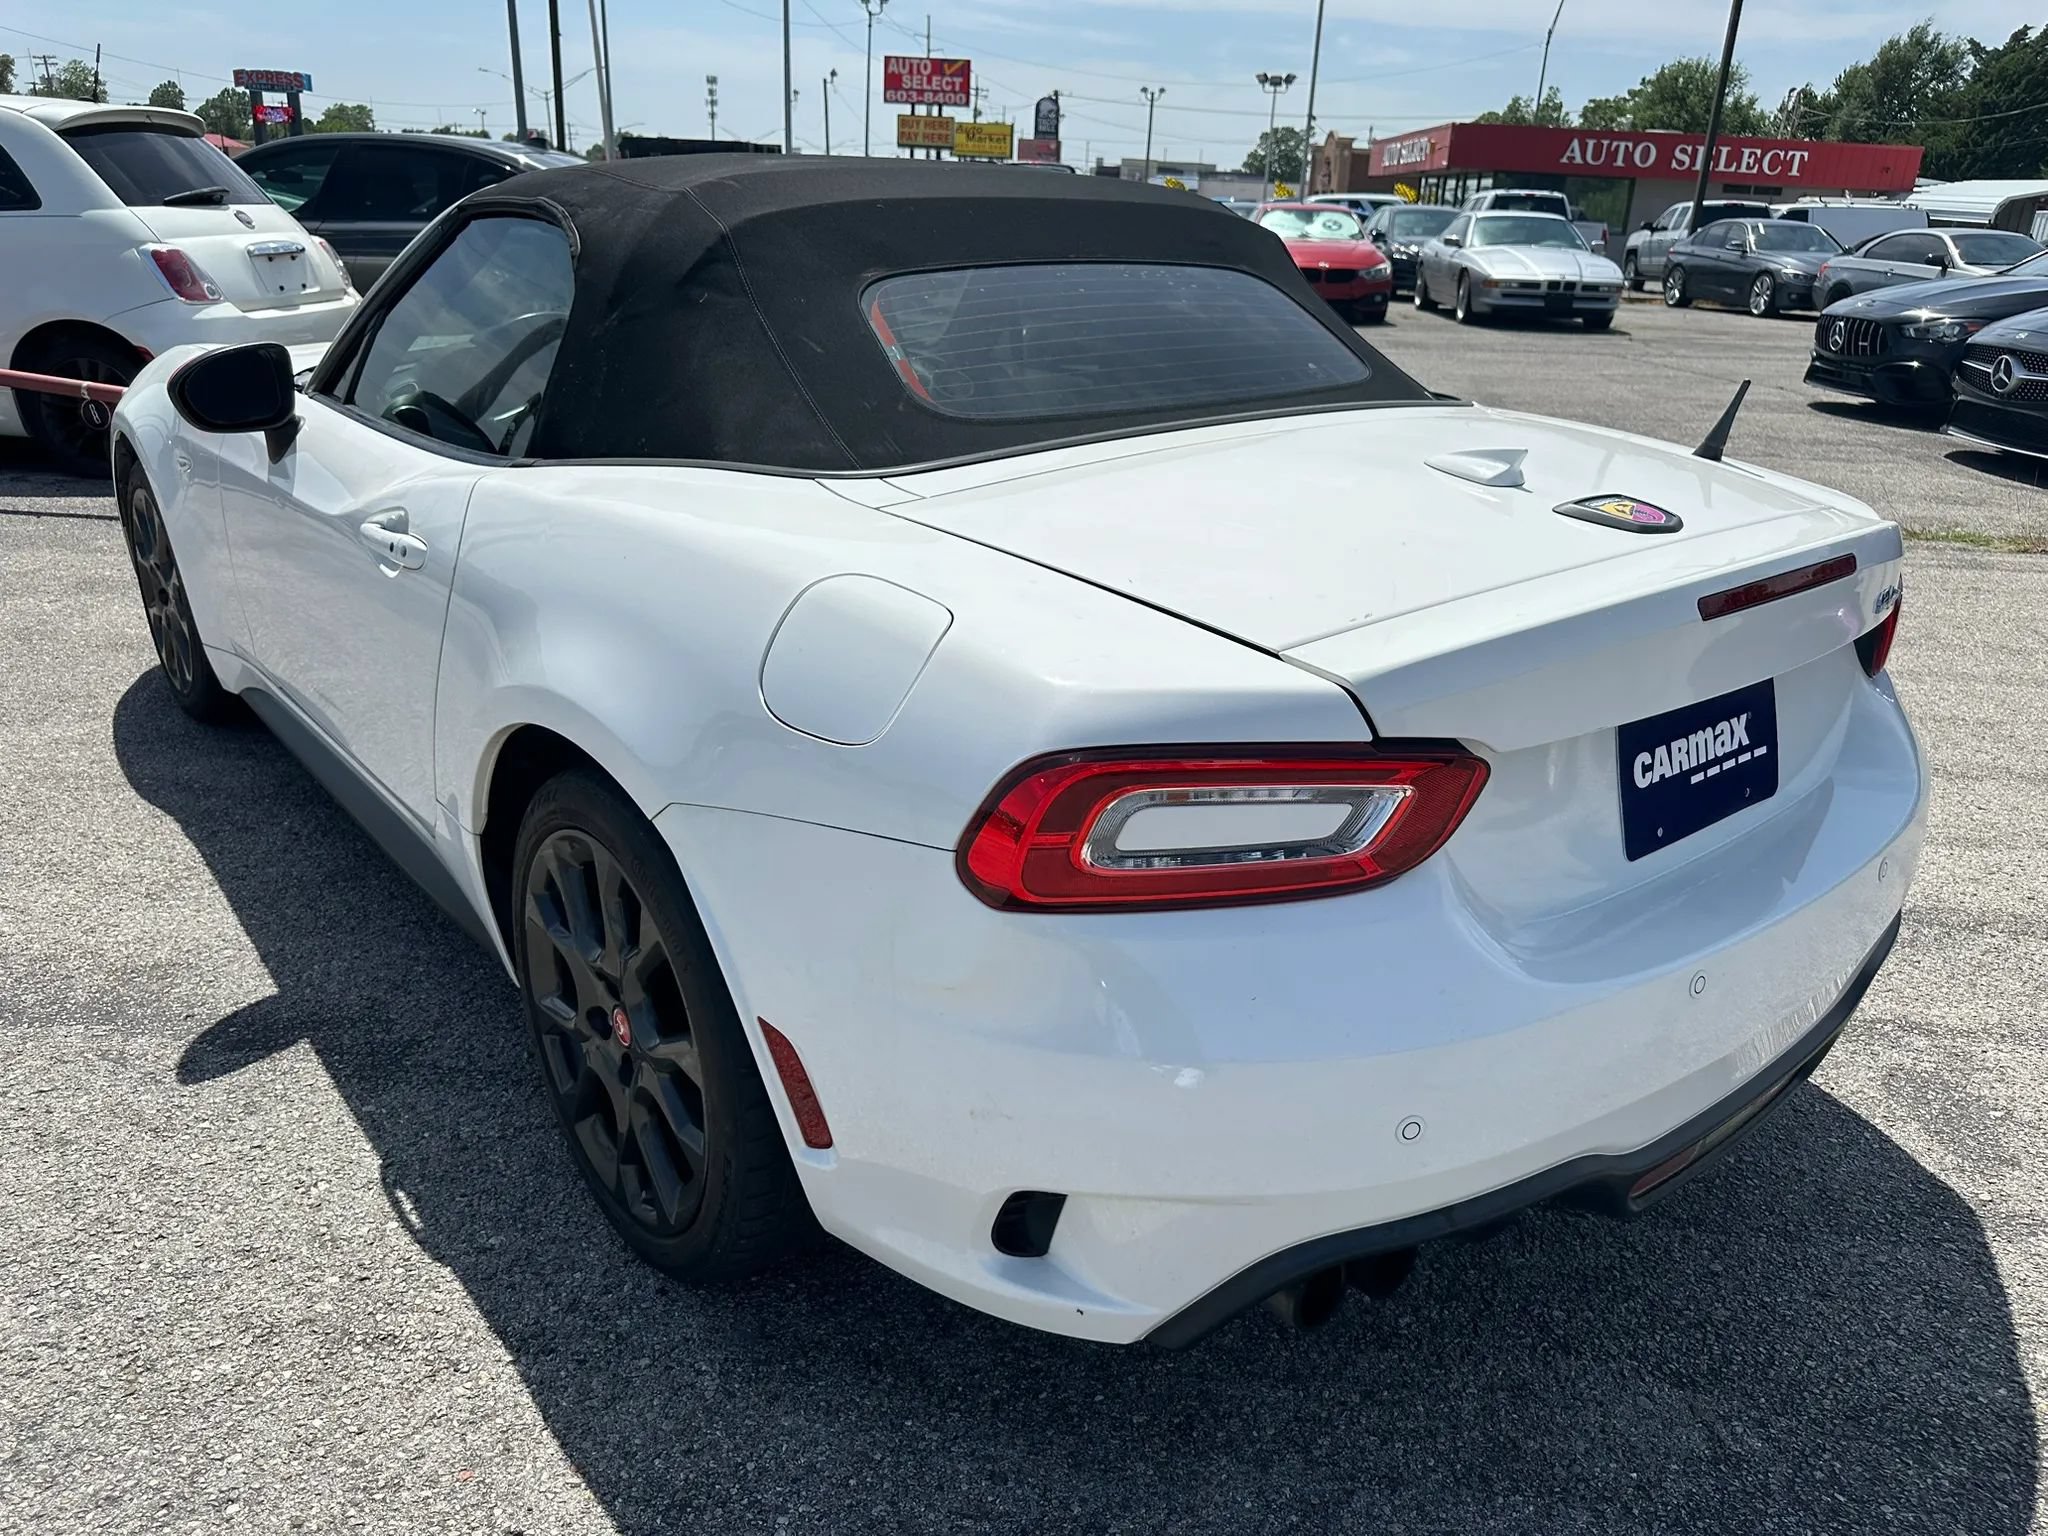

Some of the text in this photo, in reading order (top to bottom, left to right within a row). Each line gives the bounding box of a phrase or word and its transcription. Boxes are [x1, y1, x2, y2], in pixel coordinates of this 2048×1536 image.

[888, 58, 932, 75] AUTO
[234, 69, 305, 89] EXPRESS
[901, 75, 963, 92] SELECT
[886, 90, 967, 105] 603-8400
[901, 118, 950, 131] BUY HERE
[900, 131, 950, 144] PAY HERE
[966, 132, 1008, 145] Market
[1560, 137, 1657, 168] AUTO
